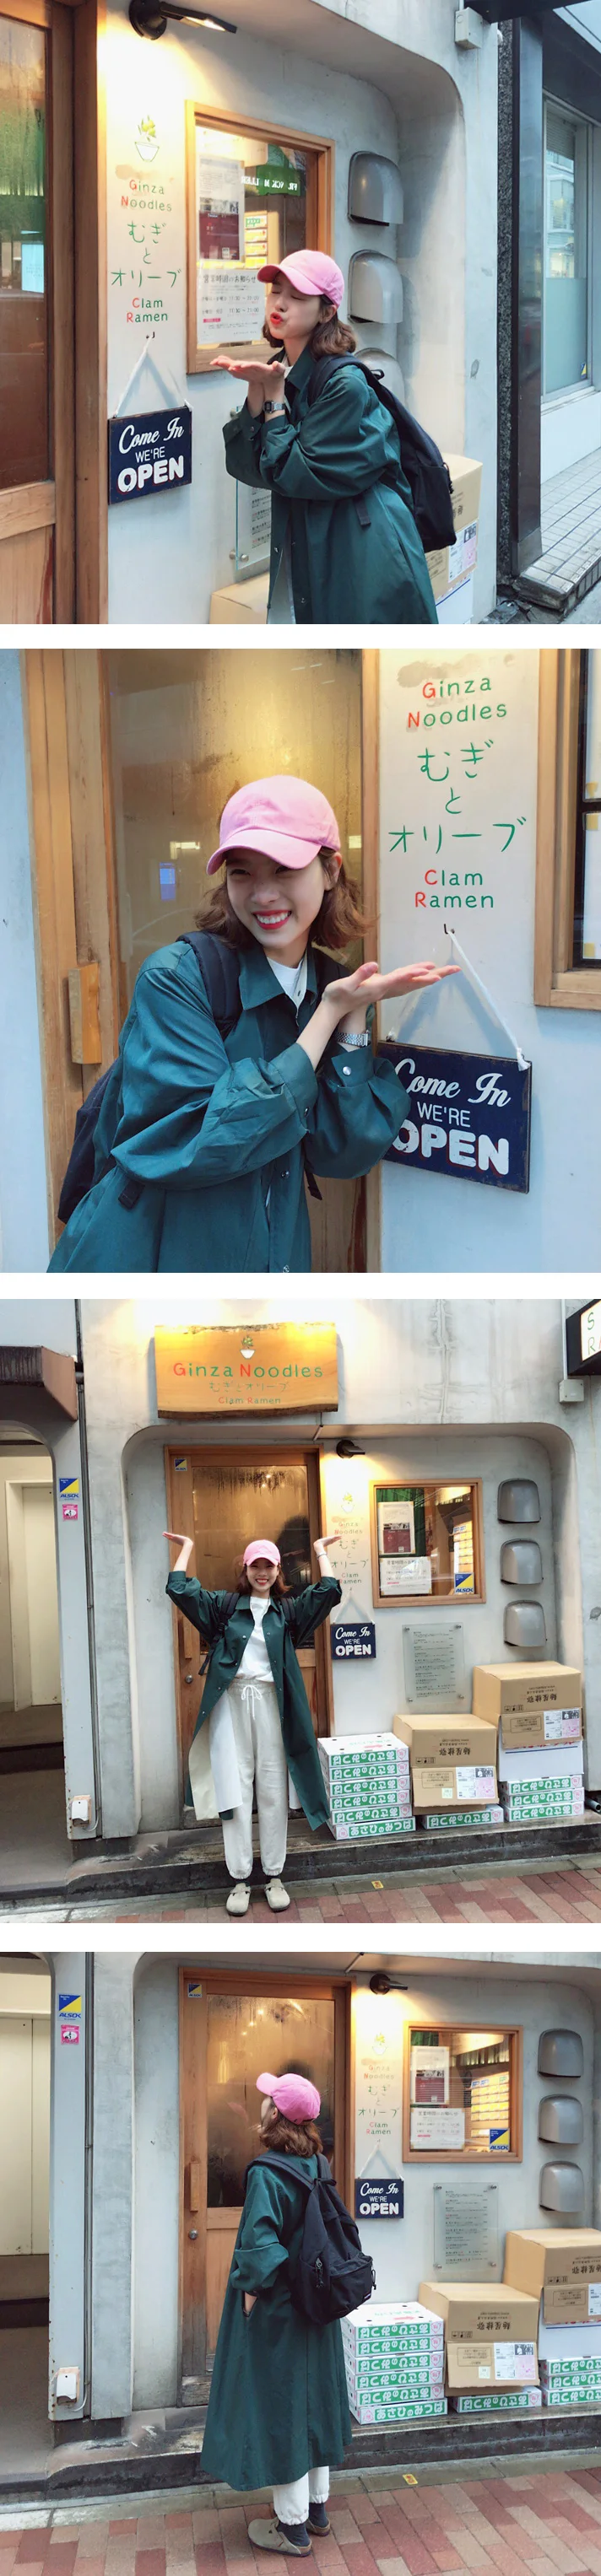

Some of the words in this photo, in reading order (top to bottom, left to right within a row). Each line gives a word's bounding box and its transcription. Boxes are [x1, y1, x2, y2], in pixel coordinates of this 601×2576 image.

[129, 179, 165, 195] Ginza
[121, 196, 172, 212] Noodles
[127, 220, 166, 244] むぎ
[143, 247, 152, 265] と
[111, 267, 182, 288] オリーブ
[132, 297, 163, 309] Clam
[127, 311, 169, 323] Ramen
[119, 424, 160, 454] Come
[163, 417, 185, 441] In
[135, 446, 165, 463] WE'RE
[117, 455, 184, 493] OPEN
[422, 677, 492, 698] Ginza
[408, 703, 507, 728] Noodles
[417, 739, 494, 782] むぎ
[445, 787, 463, 815] と
[388, 816, 527, 854] オリーブ
[425, 869, 484, 887] Clam
[414, 892, 494, 908] Ramen
[395, 1058, 461, 1099] Come
[468, 1073, 512, 1107] In
[417, 1101, 471, 1128] WE'RE
[392, 1119, 510, 1176] OPEN
[173, 1362, 233, 1377] Ginza
[240, 1363, 323, 1377] Noodles
[209, 1381, 290, 1393] むぎとオリーブ
[219, 1396, 244, 1405] Clam
[247, 1396, 281, 1404] Ramen
[332, 1559, 369, 1569] オリーブ
[335, 1627, 357, 1640] Come
[359, 1626, 371, 1637] In
[335, 1644, 372, 1657] OPEN
[358, 2108, 400, 2118] オリーブ
[360, 2182, 384, 2196] Come
[386, 2182, 399, 2194] In
[360, 2202, 399, 2215] OPEN
